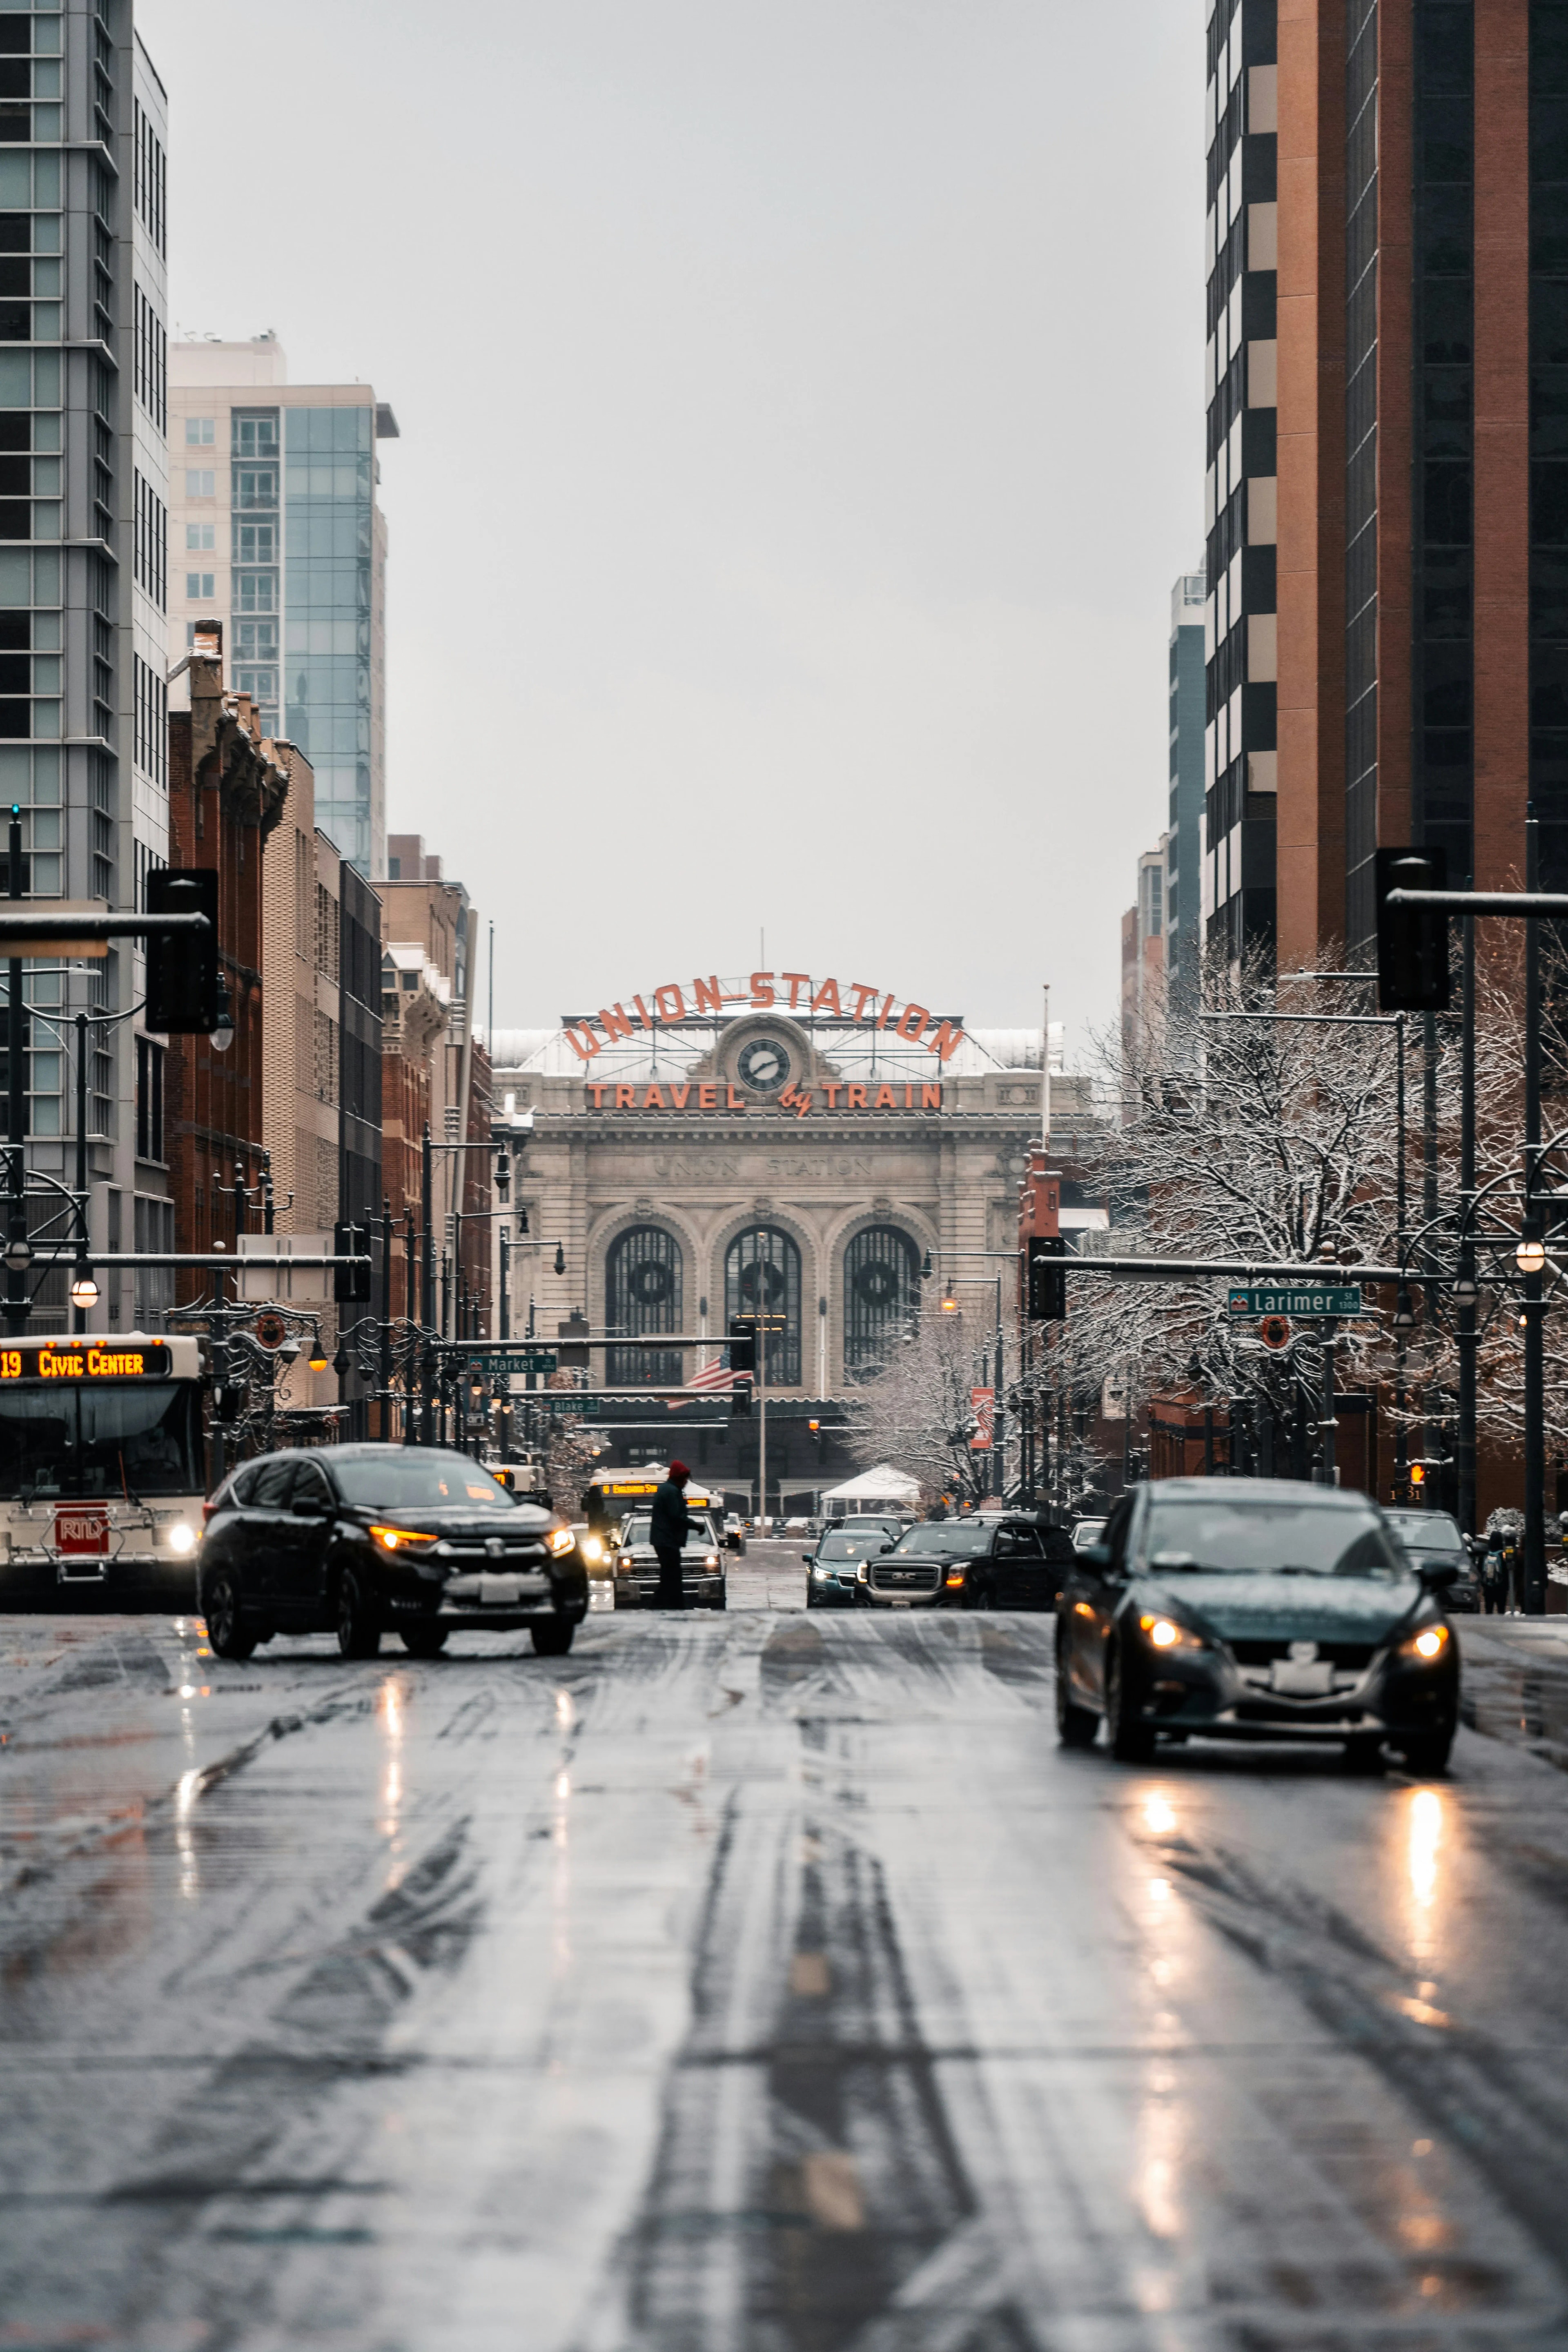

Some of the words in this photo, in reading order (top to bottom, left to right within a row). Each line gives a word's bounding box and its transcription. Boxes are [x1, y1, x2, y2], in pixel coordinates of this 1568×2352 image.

[564, 975, 722, 1060] UNION
[750, 972, 964, 1062] STATION
[588, 1083, 744, 1109] TRAVEL
[778, 1082, 812, 1117] by
[822, 1083, 941, 1108] TRAIN
[654, 1159, 738, 1175] UNION
[766, 1159, 871, 1175] STATION
[1255, 1292, 1333, 1311] Larimer
[0, 1351, 21, 1378] 19
[38, 1350, 84, 1378] CIVIC
[87, 1349, 144, 1376] CENTER
[488, 1358, 535, 1370] Market
[555, 1401, 584, 1411] Blake
[1390, 1486, 1421, 1499] 131
[60, 1519, 103, 1540] RTD
[892, 1572, 916, 1580] GMC
